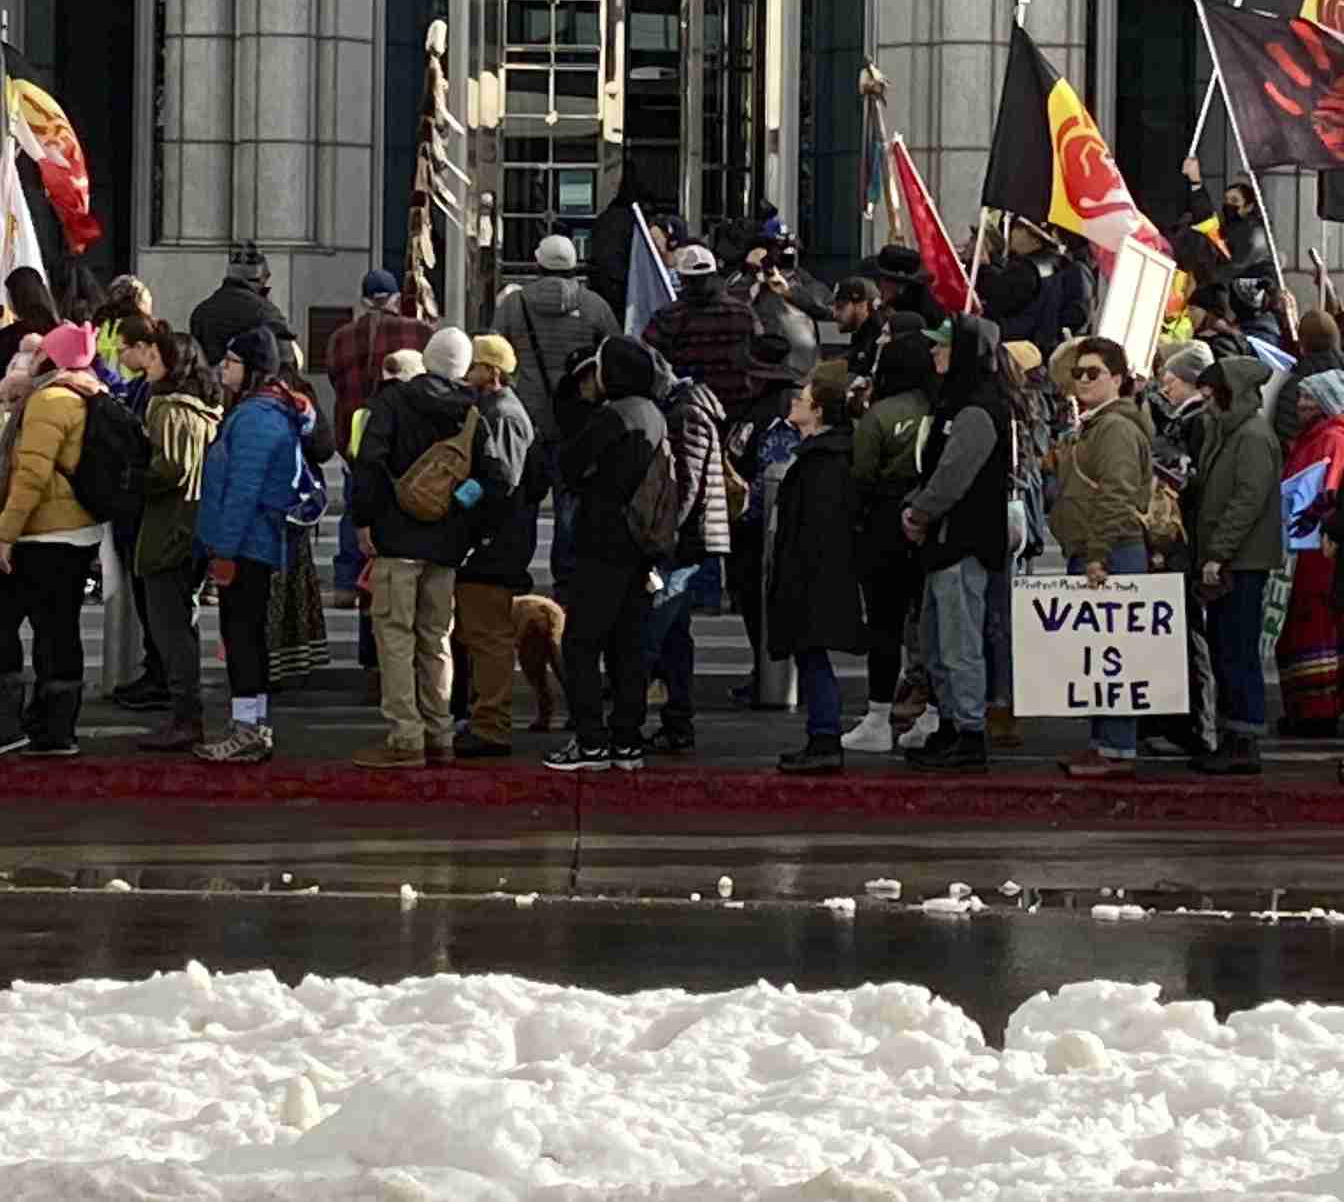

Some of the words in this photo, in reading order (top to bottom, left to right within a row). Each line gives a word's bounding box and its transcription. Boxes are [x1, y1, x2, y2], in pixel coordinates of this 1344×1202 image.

[1032, 597, 1174, 635] WATER
[1084, 646, 1123, 677] IS
[1068, 681, 1151, 710] LIFE
